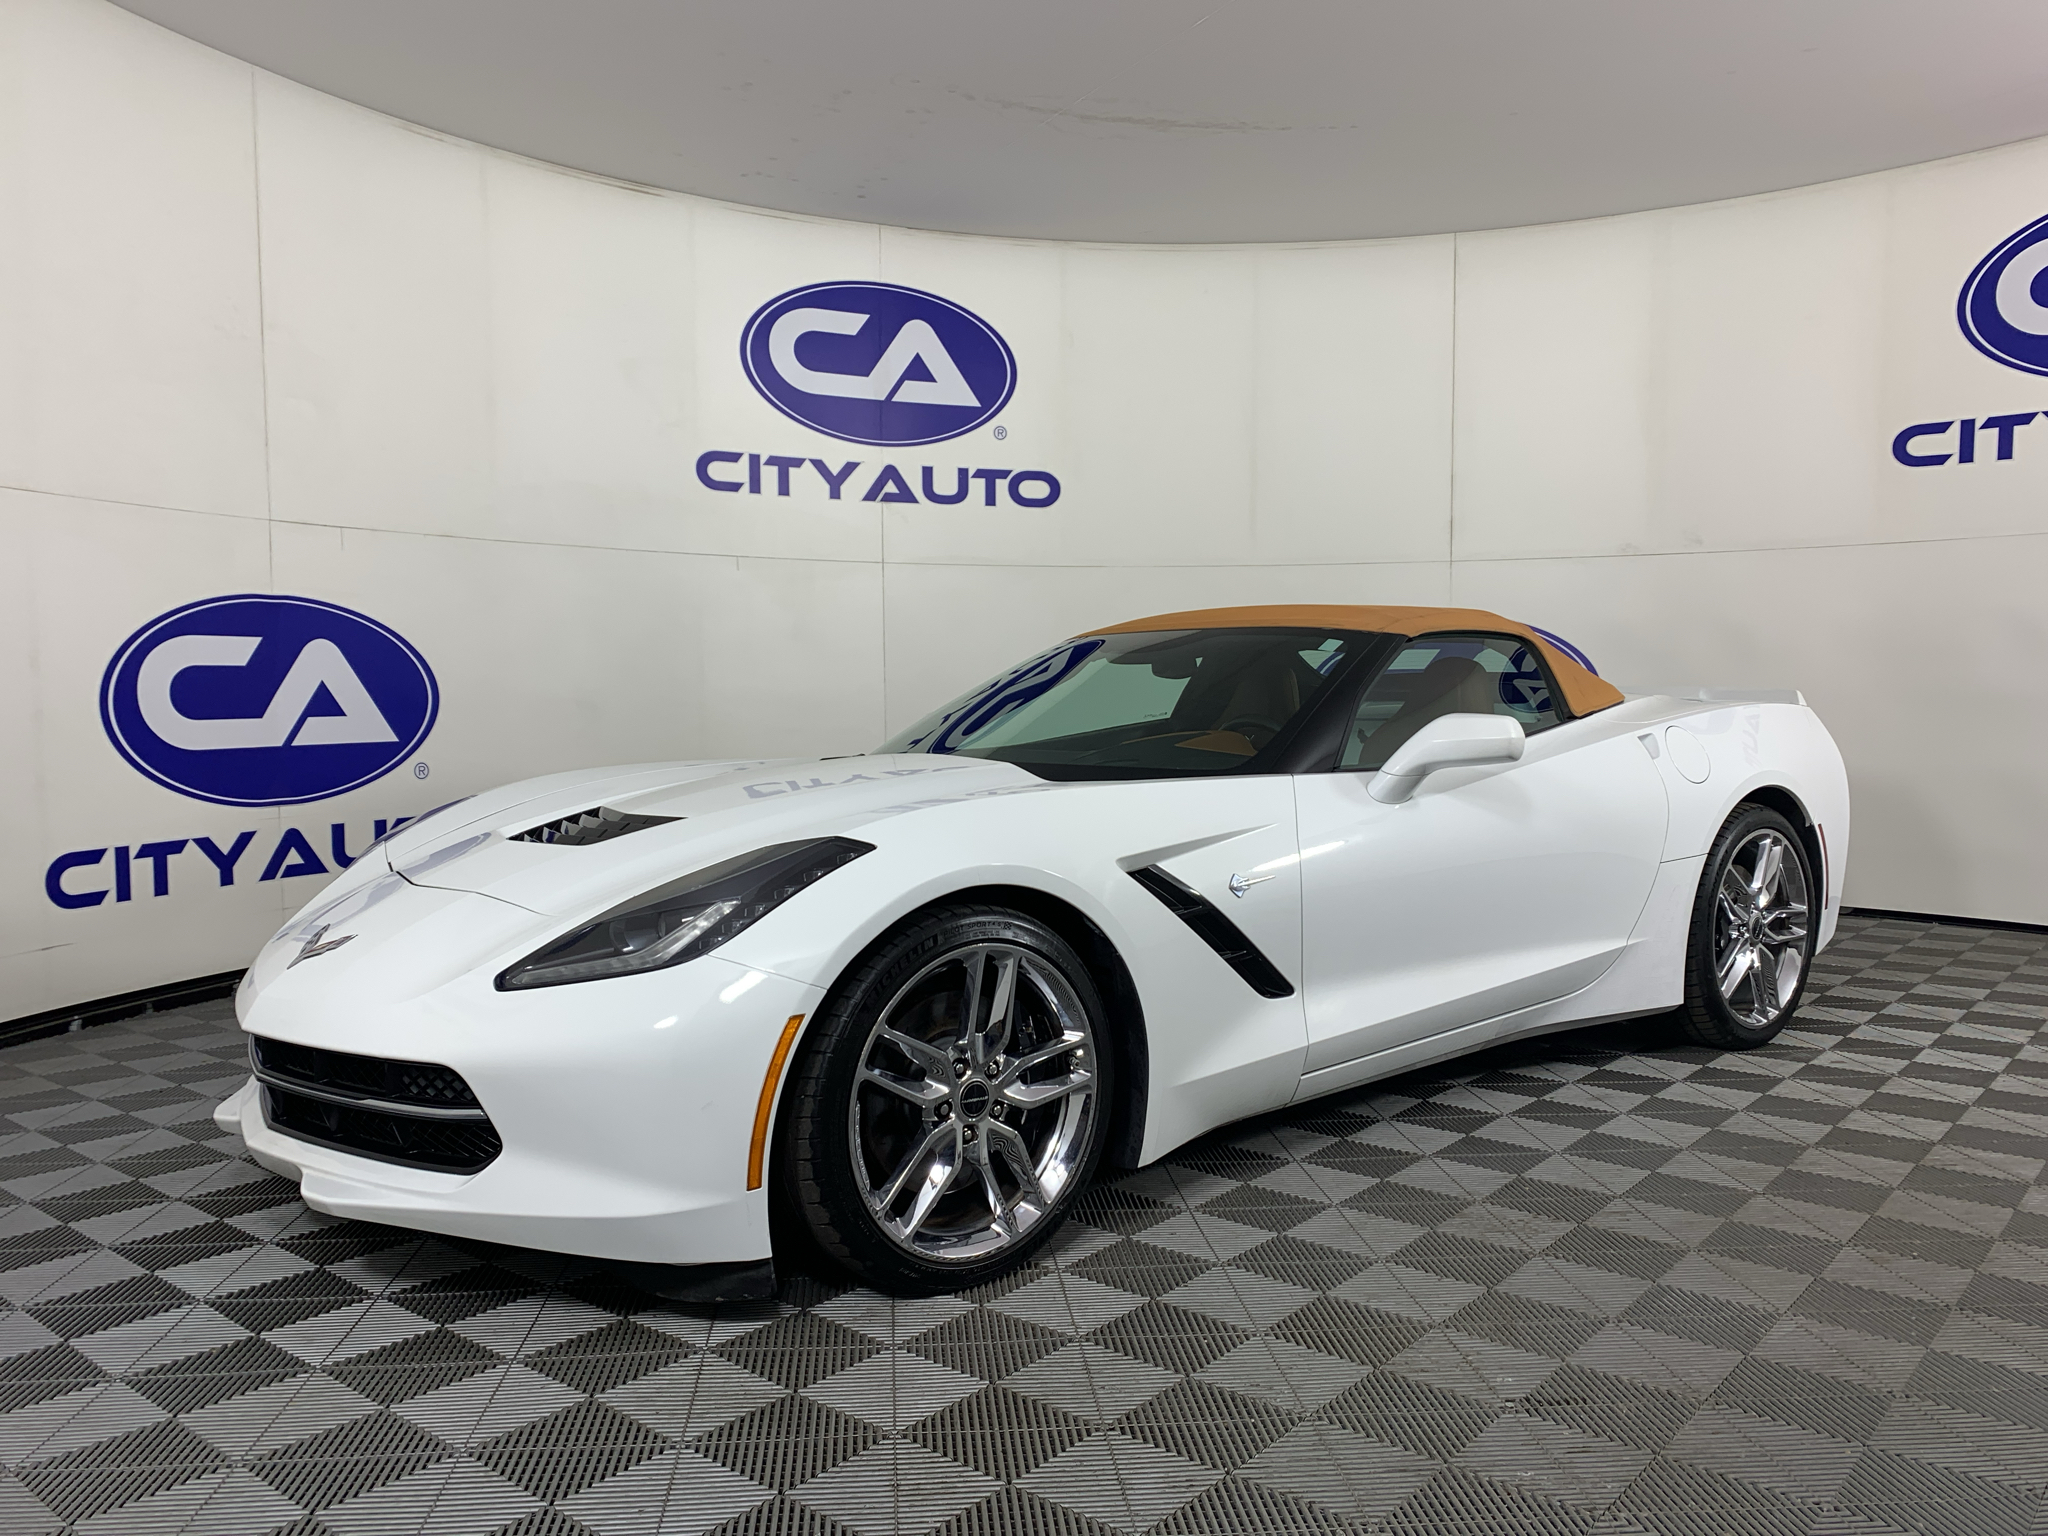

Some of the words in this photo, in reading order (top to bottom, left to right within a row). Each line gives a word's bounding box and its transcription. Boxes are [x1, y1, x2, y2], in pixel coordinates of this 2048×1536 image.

[769, 308, 982, 407] CA
[696, 450, 861, 500] CITY
[861, 464, 1061, 508] AUTO
[1892, 410, 2048, 467] CIT
[137, 634, 400, 751] CA
[45, 830, 257, 910] CITY
[258, 816, 416, 882] AU
[865, 934, 937, 1008] MICHELIN
[943, 924, 964, 937] PILOT
[967, 921, 991, 930] SPORT
